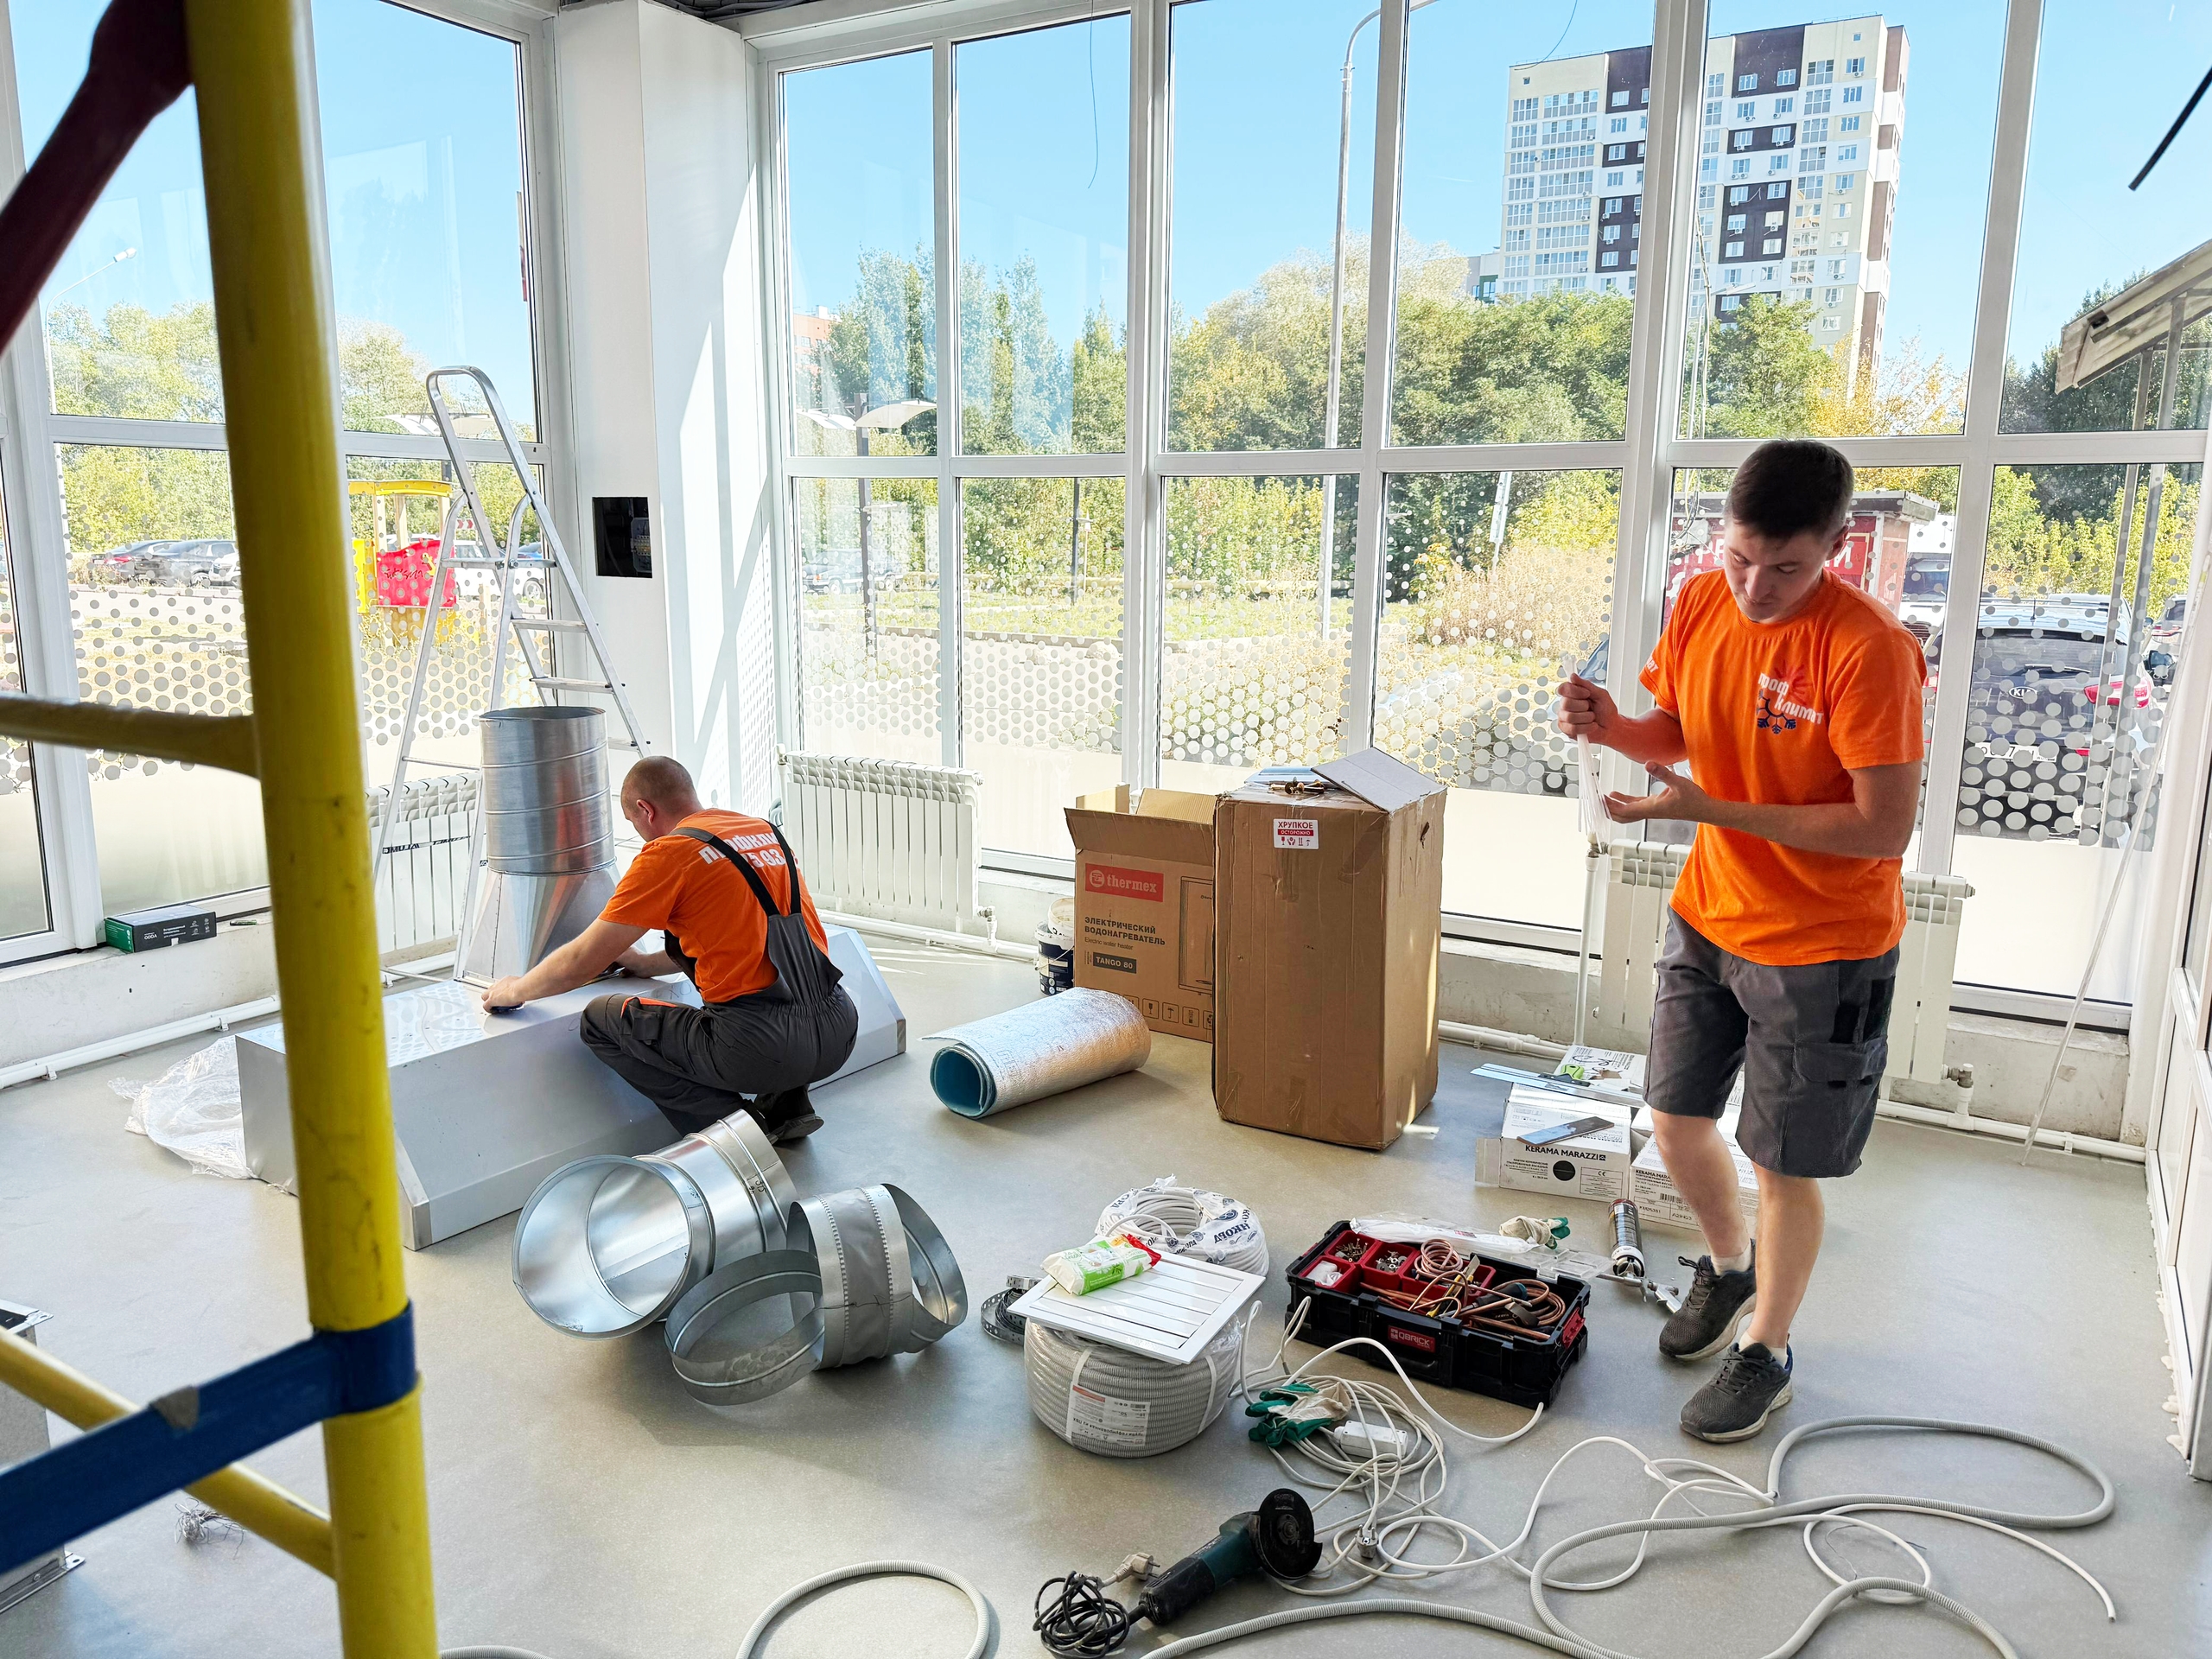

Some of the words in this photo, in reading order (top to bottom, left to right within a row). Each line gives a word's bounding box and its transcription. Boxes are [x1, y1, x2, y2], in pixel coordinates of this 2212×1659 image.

[1107, 875, 1157, 893] thermex
[1084, 916, 1156, 934] ЭЛЕКТРИЧЕСКИЙ
[1084, 926, 1166, 945] ВОДОНАГРЕВАТЕЛЬ
[1096, 957, 1122, 967] TANGO
[1123, 961, 1134, 969] 80
[1525, 1145, 1559, 1155] KERAMA
[1560, 1149, 1599, 1160] MARAZZI
[1398, 1332, 1430, 1346] QBRICK
